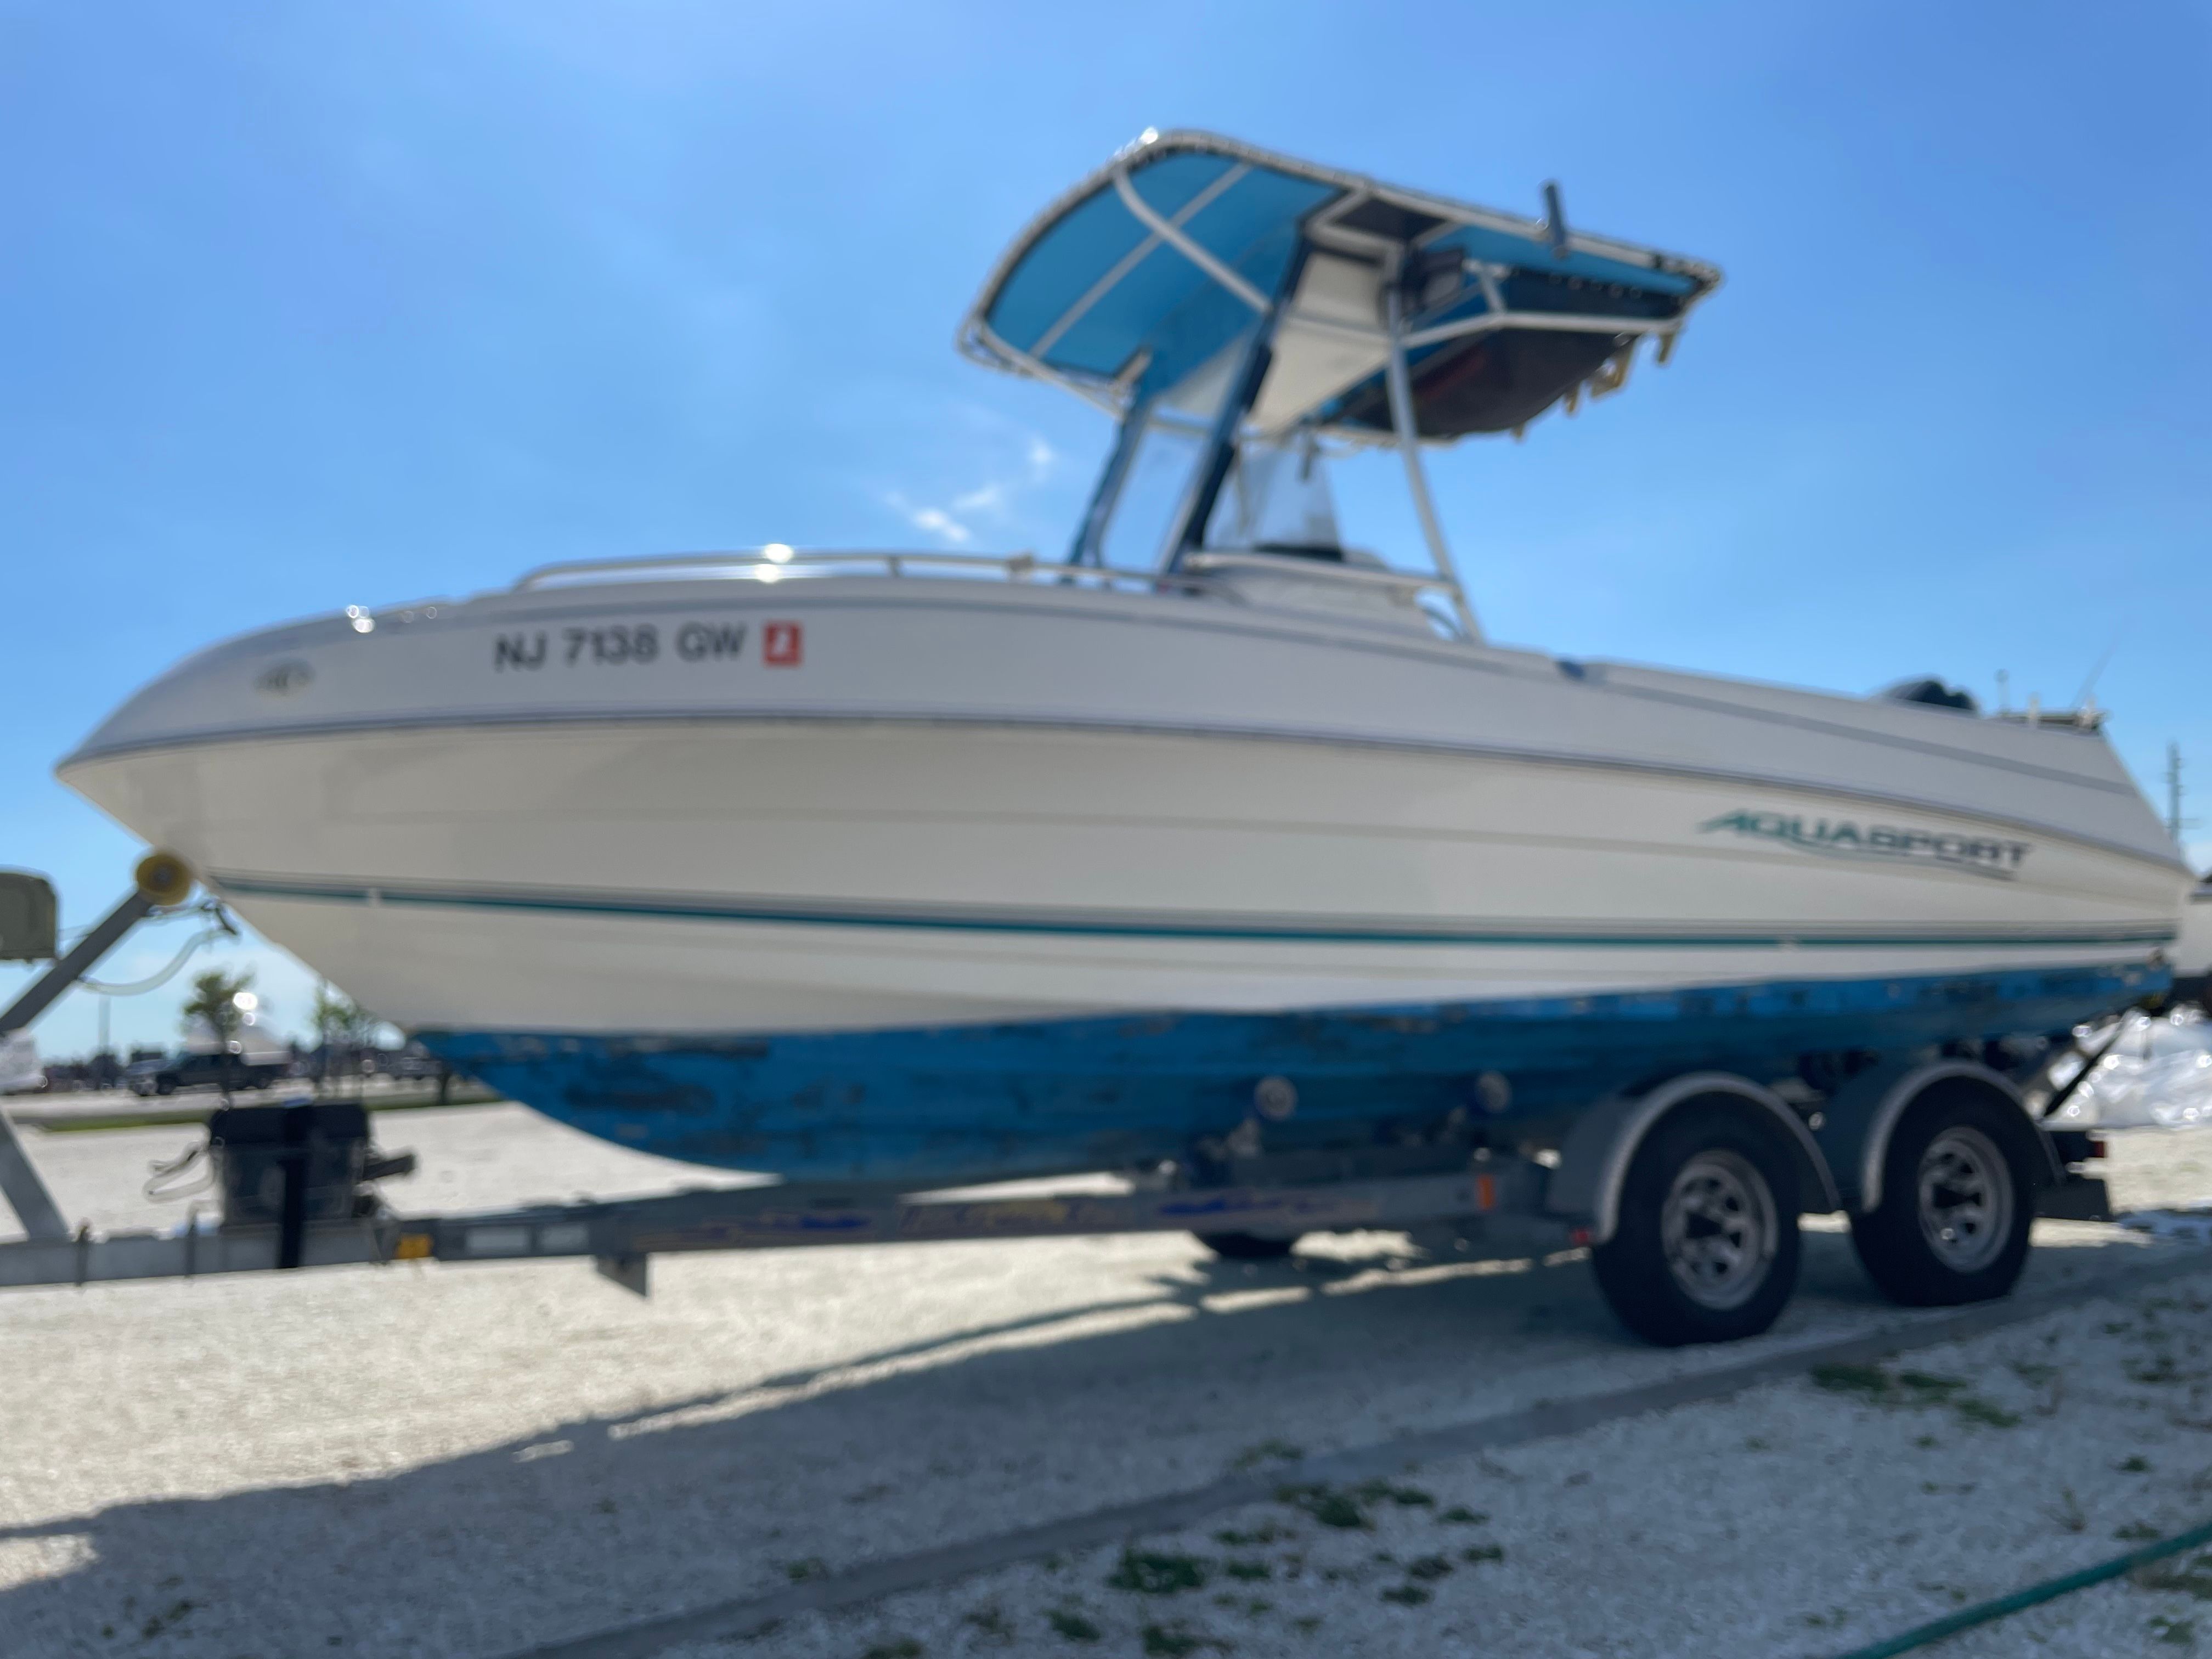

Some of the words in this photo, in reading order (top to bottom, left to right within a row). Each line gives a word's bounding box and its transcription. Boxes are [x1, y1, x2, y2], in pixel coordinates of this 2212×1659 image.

[494, 633, 546, 673] NJ
[676, 620, 747, 661] GW
[1699, 809, 2033, 868] AQUASPORT
